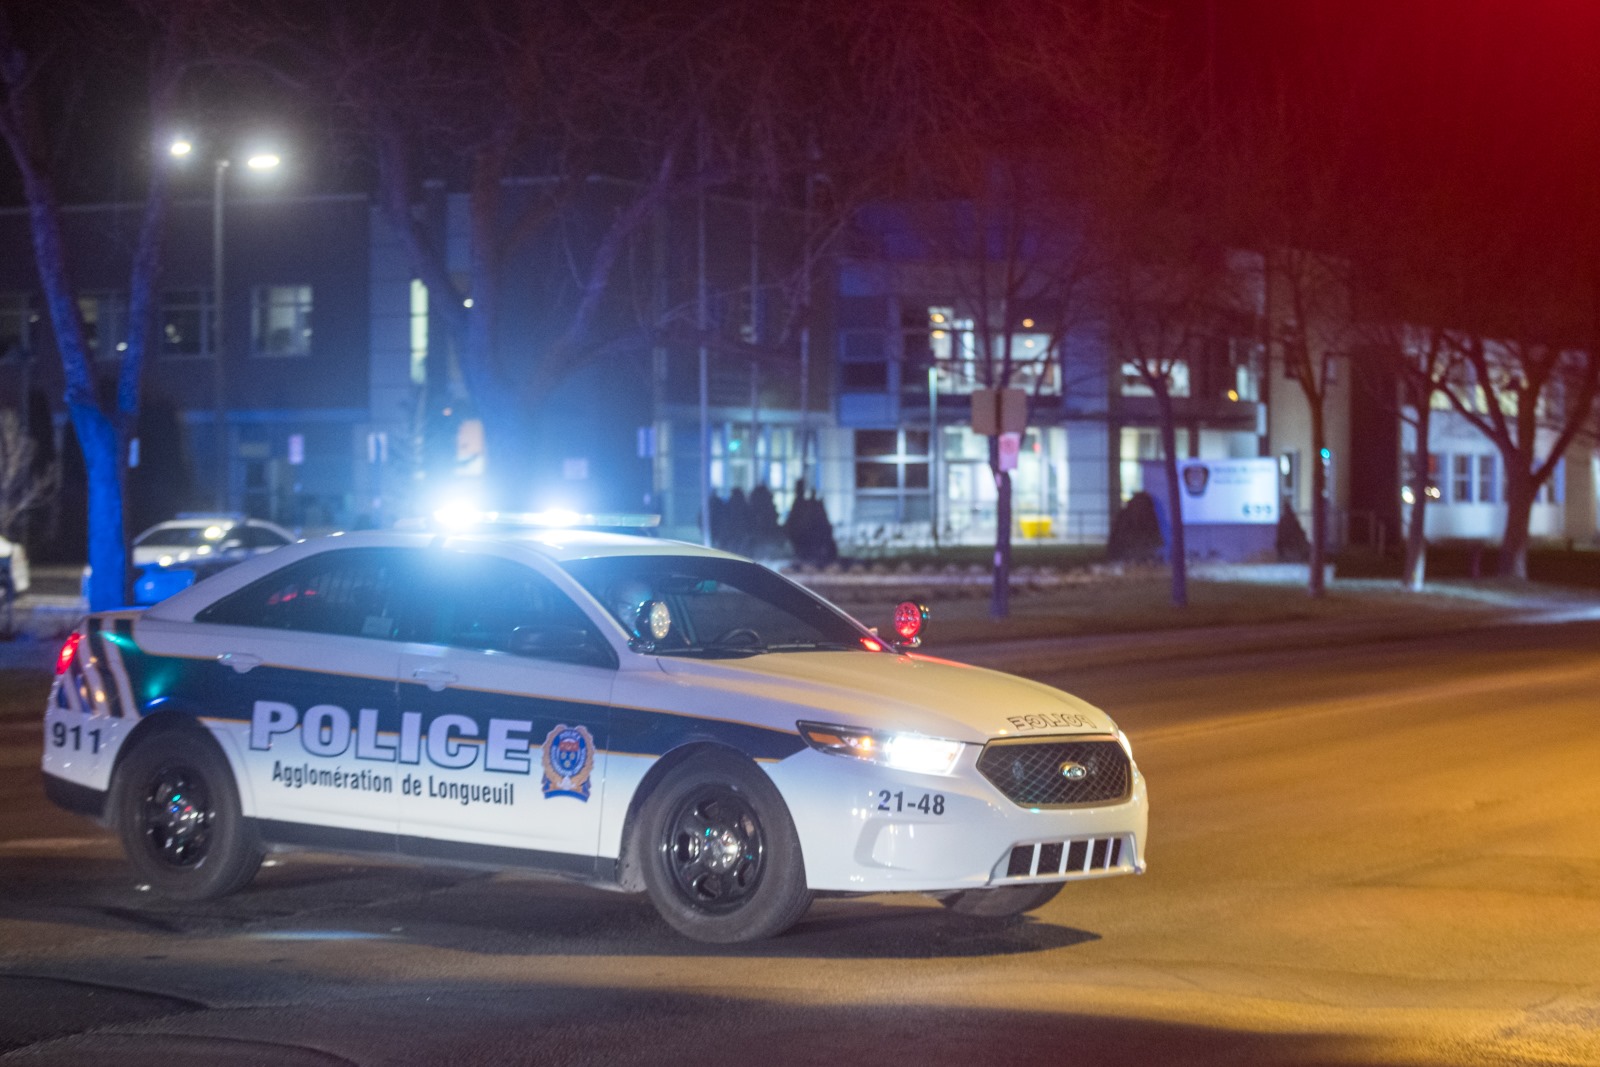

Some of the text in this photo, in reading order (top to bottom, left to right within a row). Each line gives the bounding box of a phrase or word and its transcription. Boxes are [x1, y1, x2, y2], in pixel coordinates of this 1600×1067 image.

[52, 721, 101, 755] 911
[249, 700, 533, 775] POLICE
[272, 760, 514, 806] Agglomération de Longueuil
[877, 789, 945, 816] 21-48
